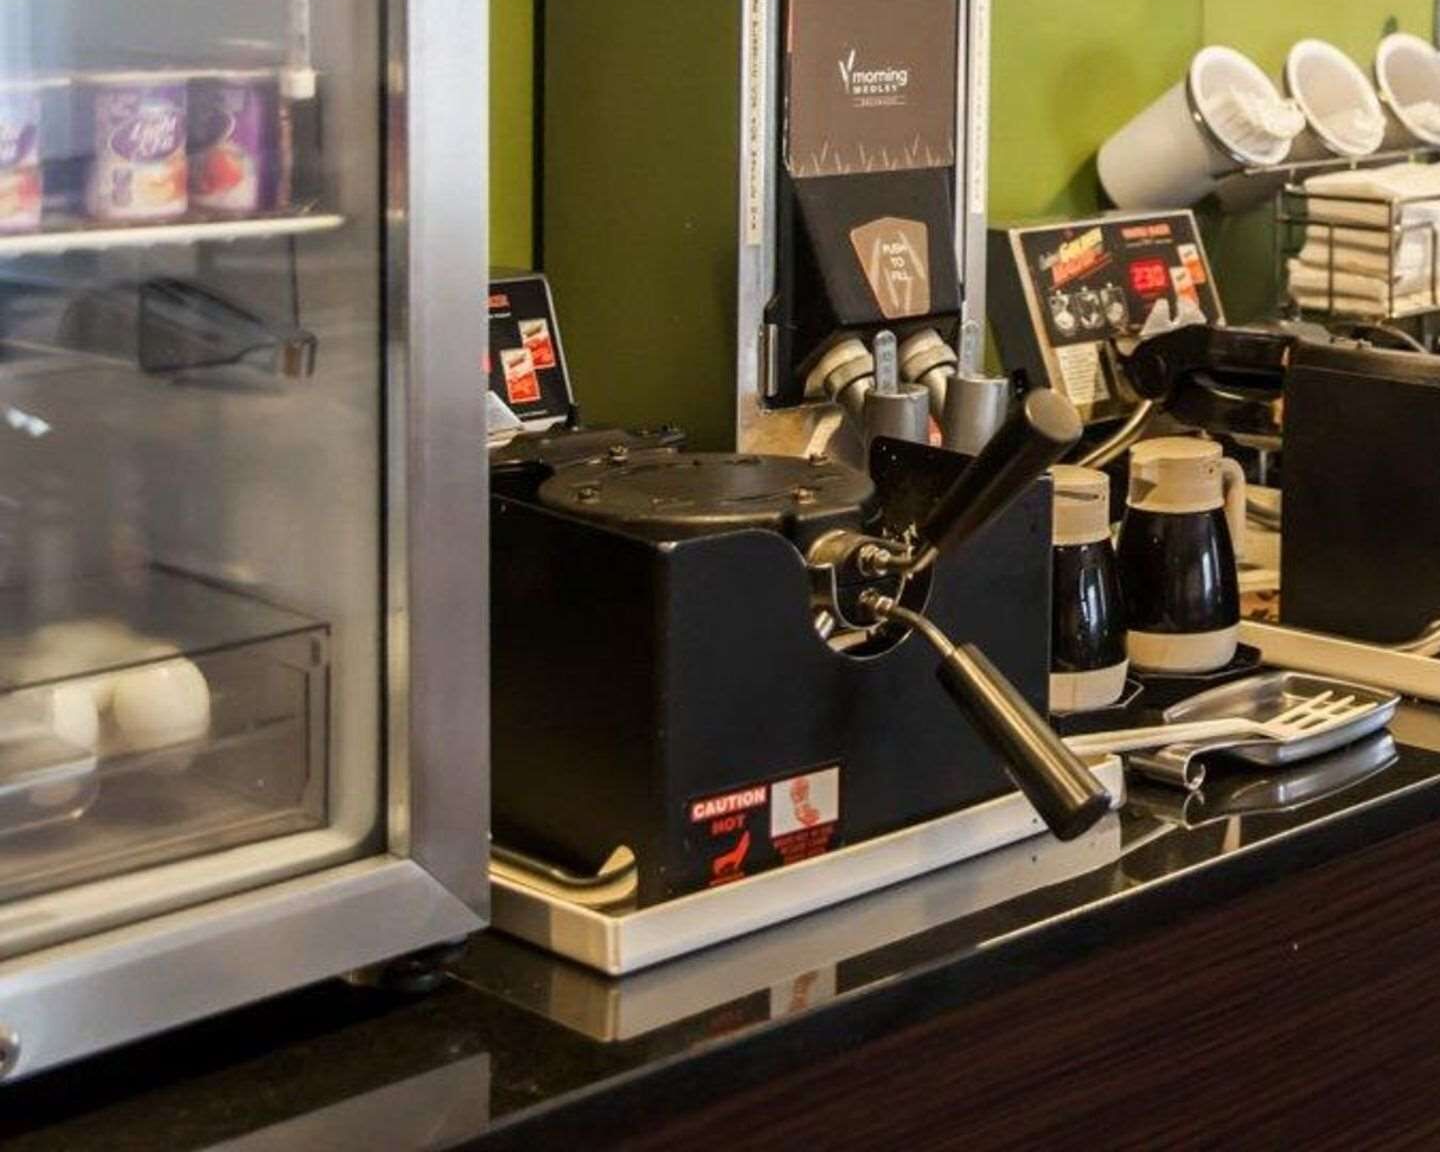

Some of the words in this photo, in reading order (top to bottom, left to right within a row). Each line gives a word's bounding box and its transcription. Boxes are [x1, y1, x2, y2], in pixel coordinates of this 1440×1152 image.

[852, 67, 908, 87] morning
[691, 786, 767, 822] CAUTION
[711, 814, 745, 835] HOT
